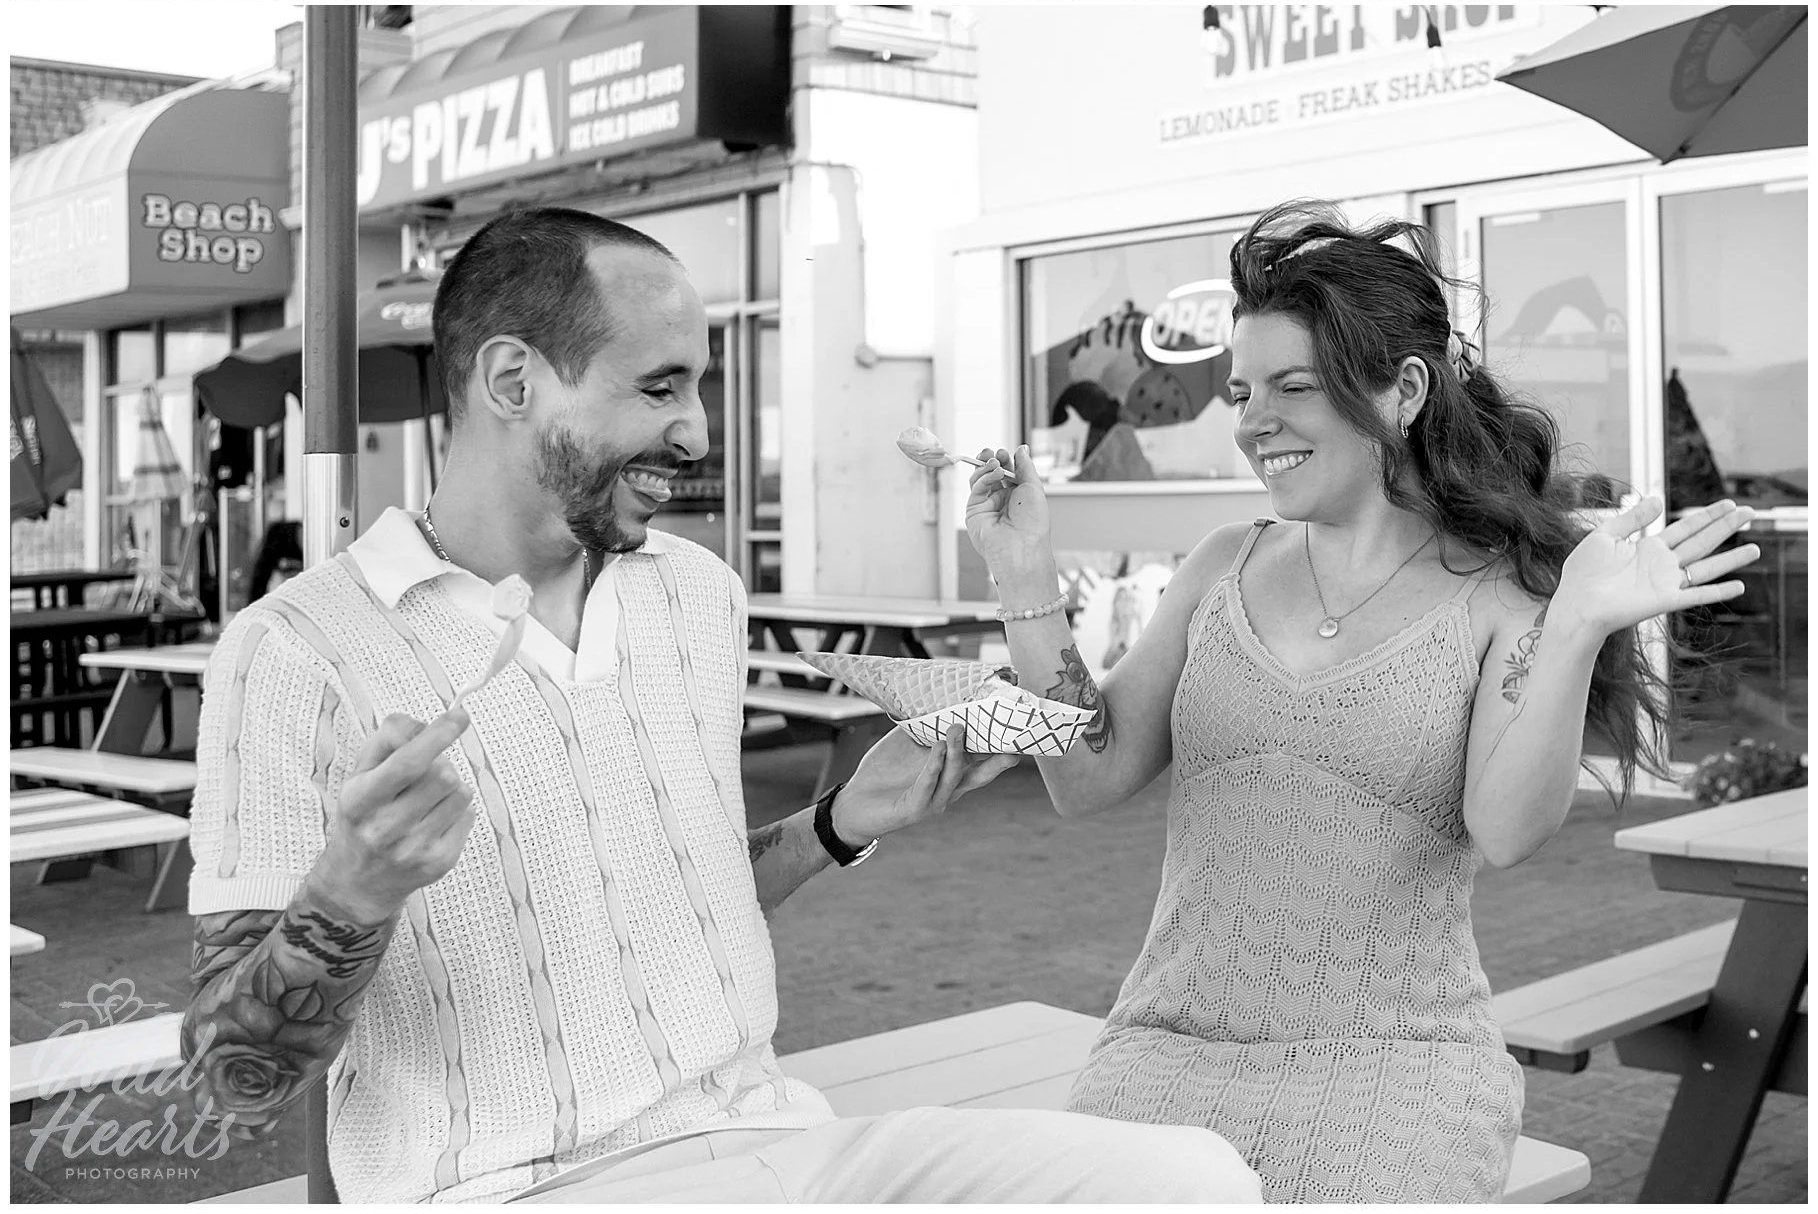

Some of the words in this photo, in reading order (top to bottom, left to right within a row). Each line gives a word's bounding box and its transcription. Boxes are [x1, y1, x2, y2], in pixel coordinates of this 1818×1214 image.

[412, 67, 555, 191] PIZZA
[1160, 98, 1281, 143] LEMONADE
[1297, 81, 1381, 118] FREAK
[1387, 60, 1493, 102] SHAKES
[143, 193, 277, 234] Beach
[158, 227, 264, 274] Shop
